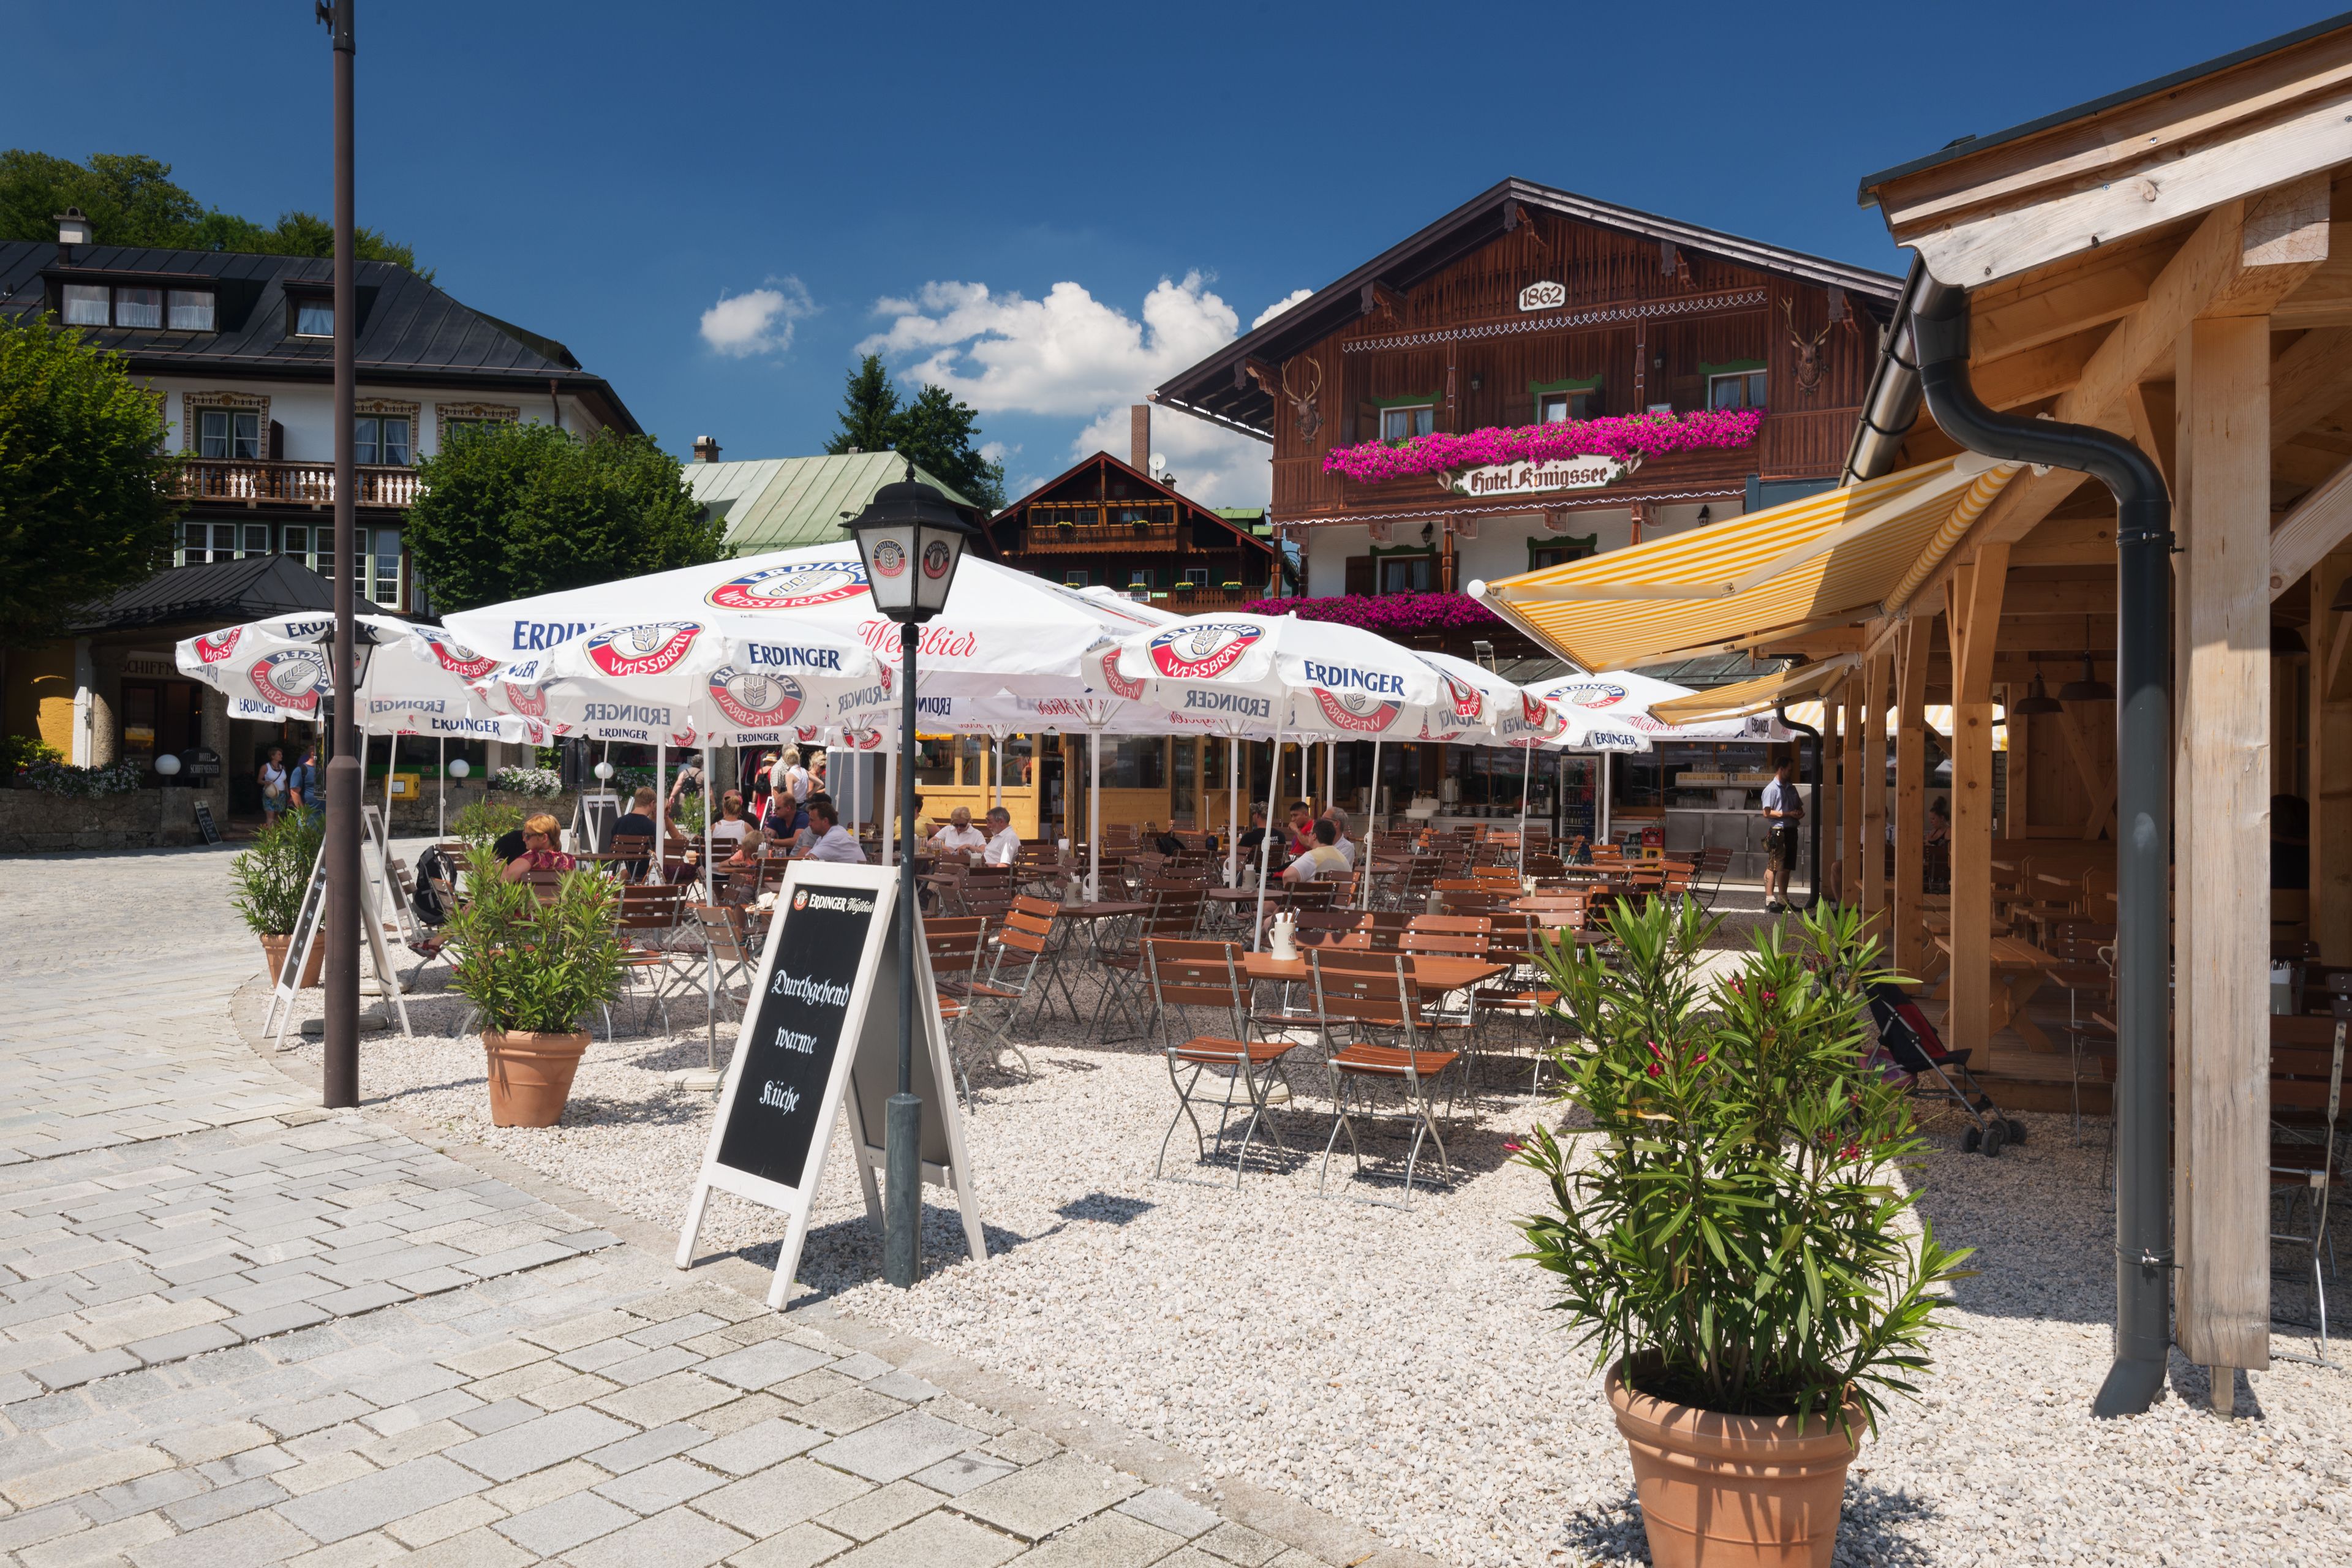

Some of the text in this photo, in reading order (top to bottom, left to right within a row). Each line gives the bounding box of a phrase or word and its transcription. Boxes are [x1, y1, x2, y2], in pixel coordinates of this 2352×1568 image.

[1522, 285, 1562, 307] 1862
[1471, 469, 1513, 494] Hotel
[875, 541, 903, 557] ERDINGER
[927, 542, 949, 559] ERDINGER
[877, 562, 903, 576] WEISSBRÄU
[718, 589, 850, 609] WEISSBRÄU
[513, 620, 597, 651] ERDIN
[1158, 624, 1257, 642] ERDINGER
[611, 634, 691, 675] WEISSBRÄU
[748, 643, 842, 671] ERDINGER
[1167, 641, 1245, 678] WEISSBRÄU
[1304, 660, 1405, 696] ERDINGER
[1551, 684, 1623, 696] ERDINGER
[432, 717, 501, 736] ERDINGER
[599, 728, 649, 741] ERDINGER
[737, 733, 780, 742] ERDINGER
[199, 753, 211, 761] HOTEL
[809, 894, 846, 912] ERDINGER
[846, 897, 875, 914] Weißbier
[771, 969, 850, 1008] Durchgehend
[775, 1026, 818, 1055] warme
[759, 1080, 800, 1116] Küche
